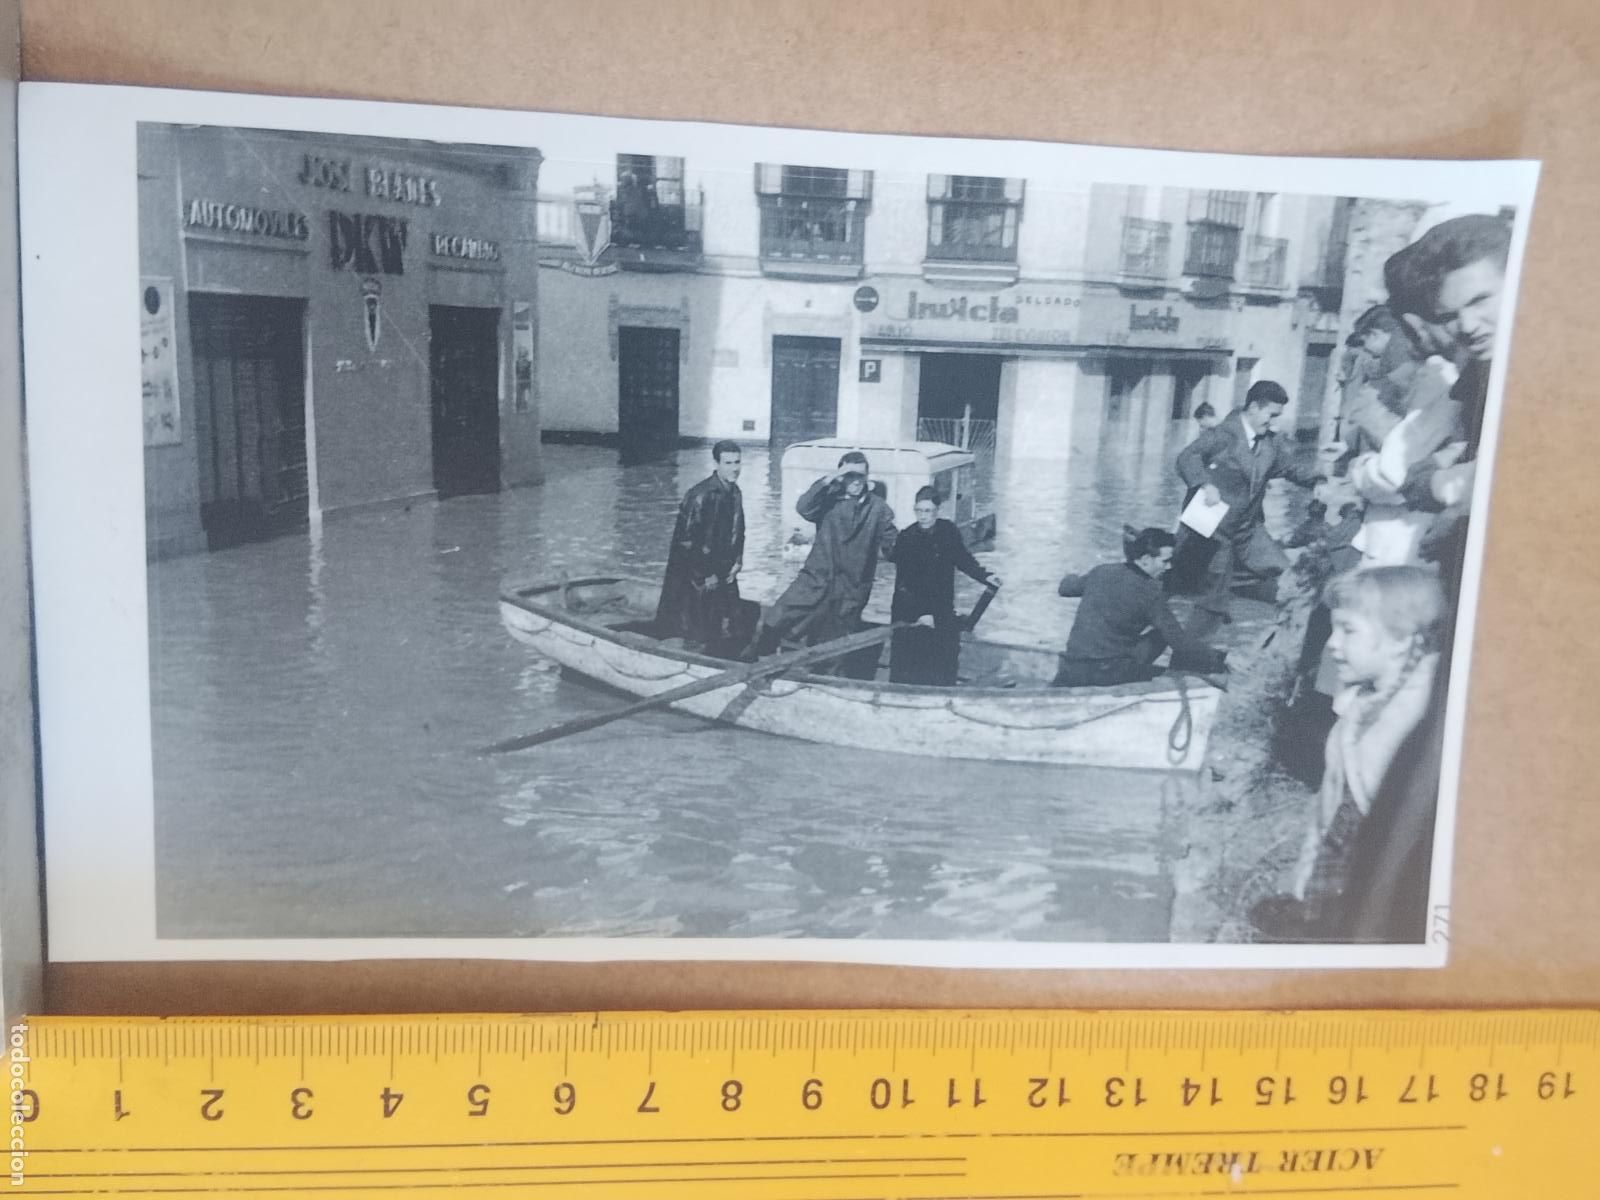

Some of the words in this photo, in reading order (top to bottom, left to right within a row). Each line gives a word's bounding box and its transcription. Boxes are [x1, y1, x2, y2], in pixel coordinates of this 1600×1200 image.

[1015, 295, 1081, 308] DELGADO
[1432, 905, 1451, 944] 271
[114, 1089, 130, 1121] 1
[200, 1089, 225, 1121] 2
[290, 1087, 314, 1120] 3
[380, 1087, 404, 1118] 4
[467, 1084, 490, 1117] 5
[553, 1083, 576, 1115] 6
[637, 1081, 660, 1113] 7
[720, 1080, 743, 1111] 8
[801, 1079, 823, 1110] 9
[870, 1078, 915, 1110] 10
[948, 1078, 987, 1109] 11
[1027, 1077, 1071, 1109] 12
[1104, 1077, 1147, 1107] 13
[1181, 1077, 1223, 1106] 14
[1255, 1077, 1296, 1106] 15
[1328, 1076, 1369, 1105] 16
[1398, 1075, 1440, 1103] 17
[1468, 1073, 1508, 1102] 18
[1537, 1072, 1576, 1100] 19
[1113, 1151, 1259, 1176] TREMPE
[1278, 1148, 1385, 1172] ACIER
